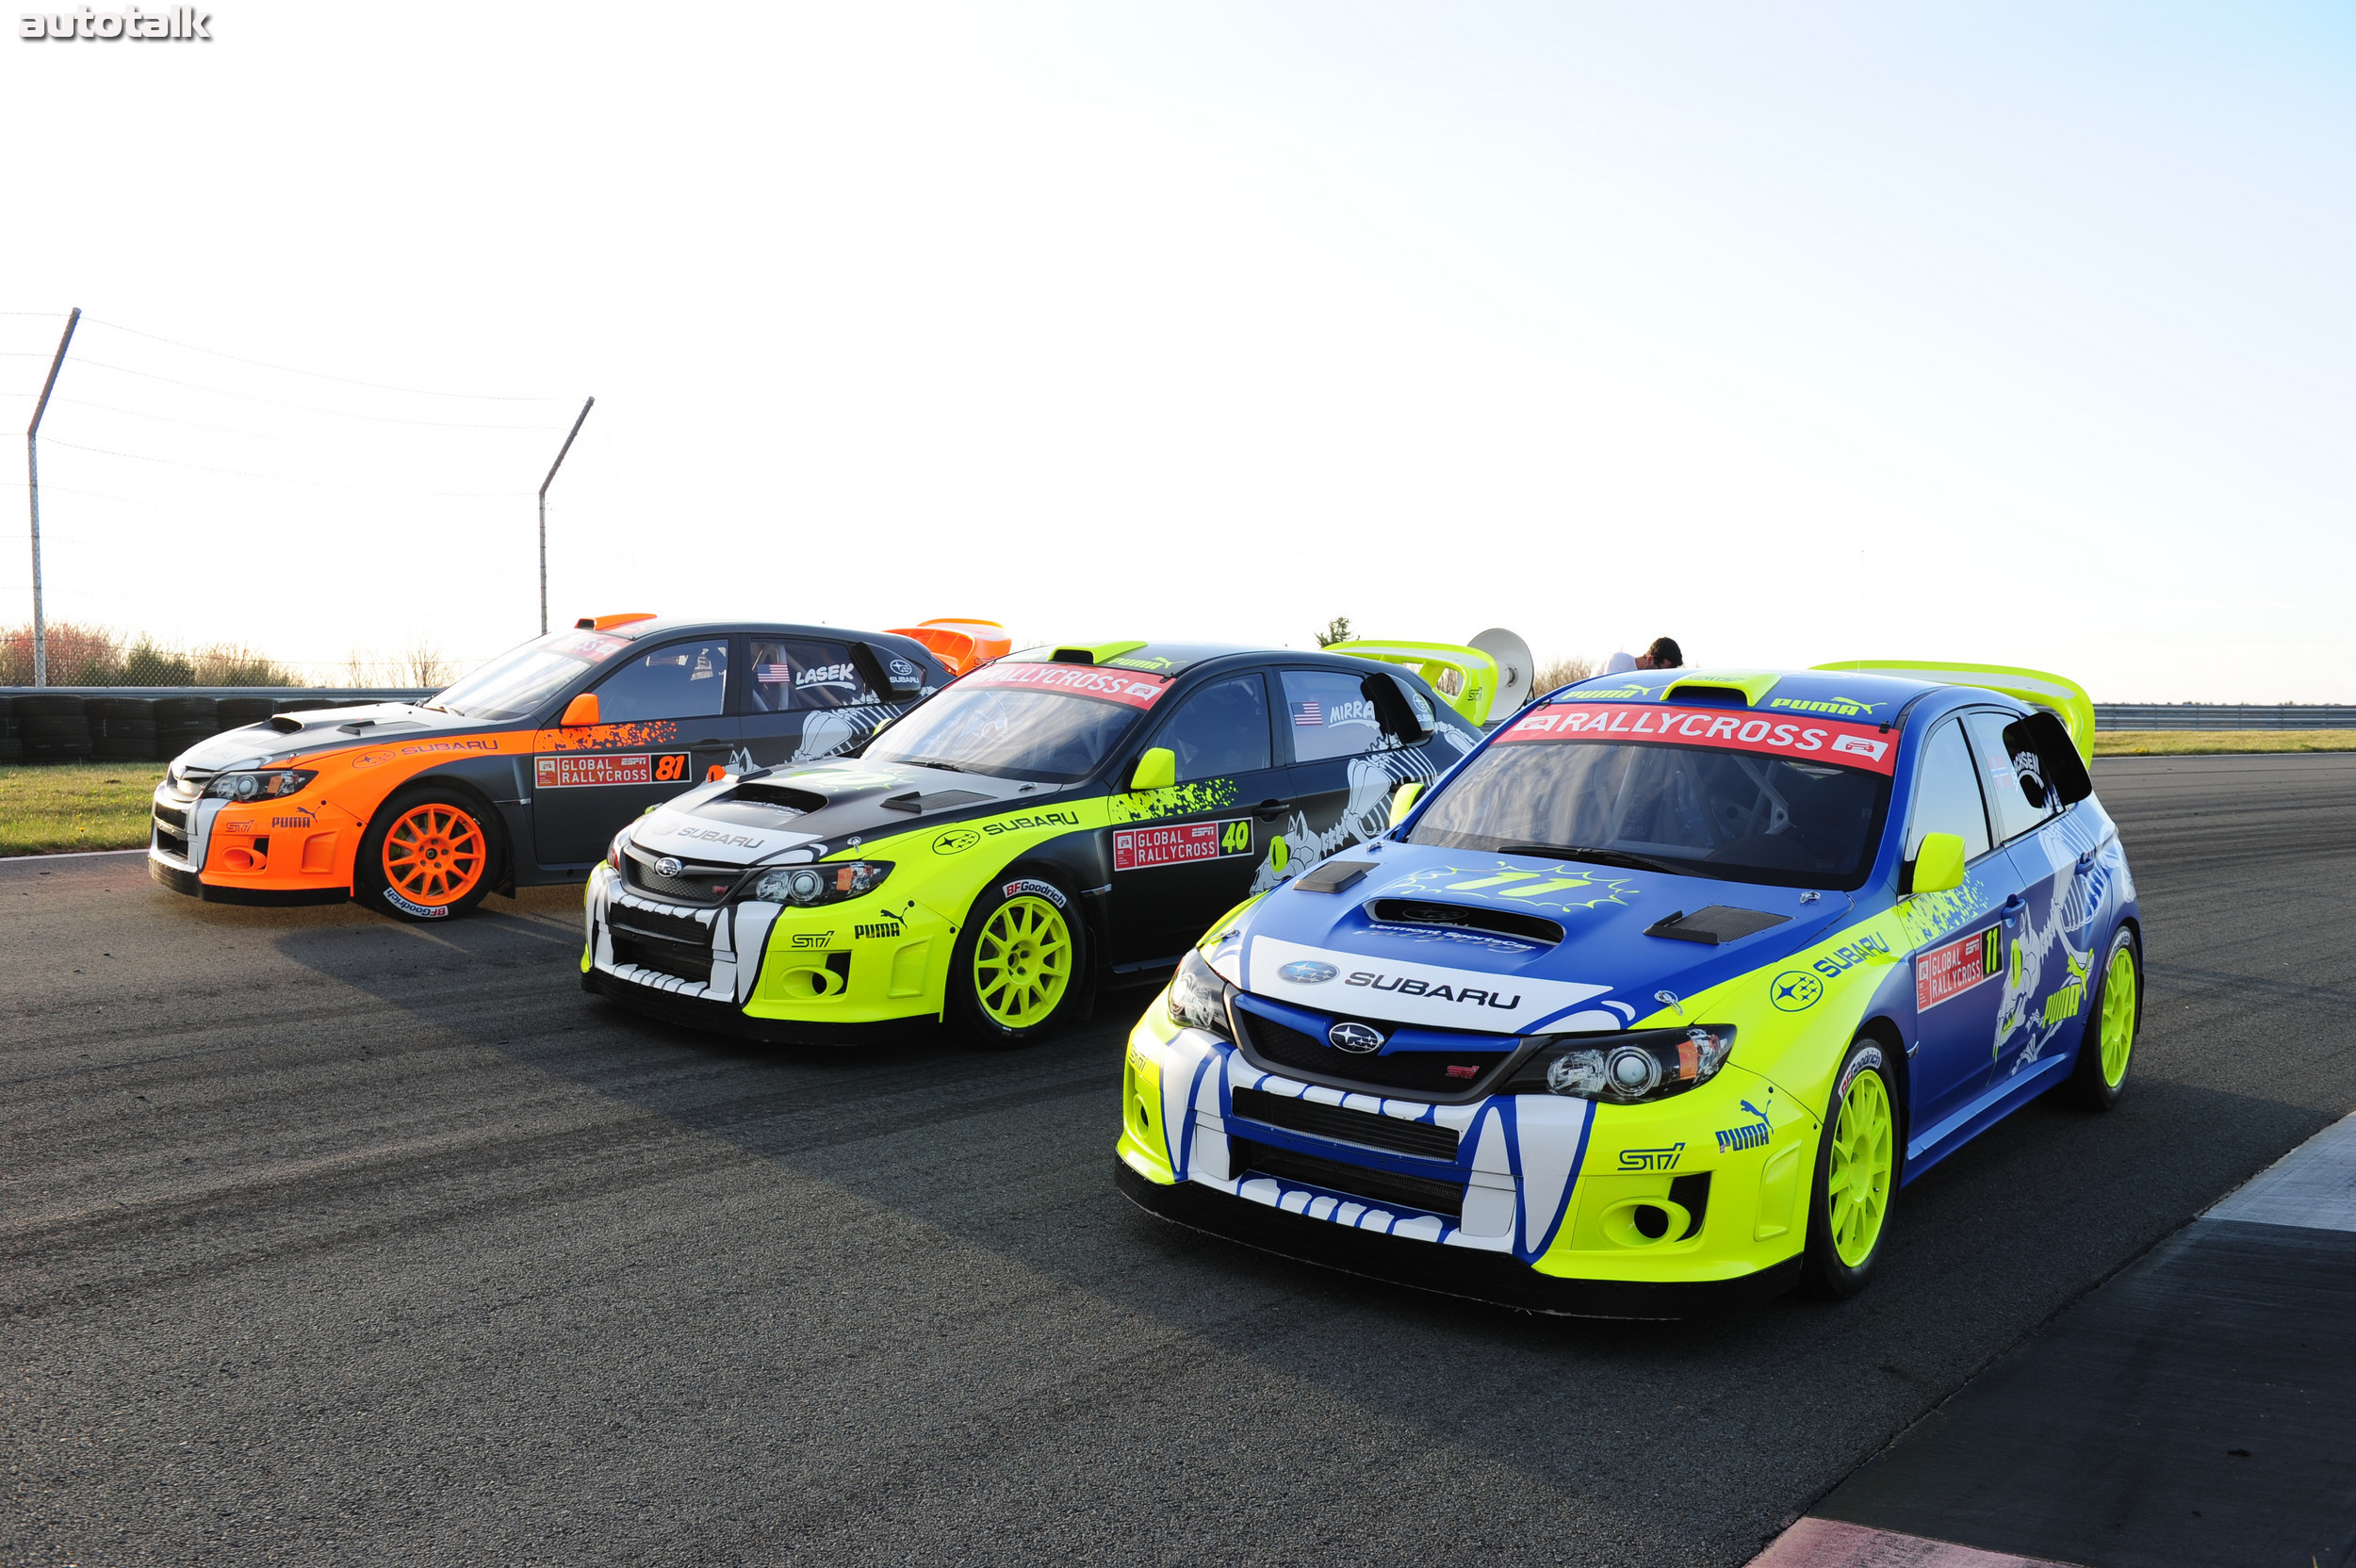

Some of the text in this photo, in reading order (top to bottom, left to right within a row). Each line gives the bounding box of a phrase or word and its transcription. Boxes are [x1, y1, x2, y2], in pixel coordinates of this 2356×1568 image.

[795, 662, 855, 685] LASEK
[1561, 690, 1639, 699] PUMA
[1330, 700, 1375, 723] MIRRA
[1770, 698, 1860, 715] PUMA
[1556, 711, 1828, 751] RALLYCROSS
[401, 740, 499, 755] SUBARU
[562, 759, 613, 771] GLOBAL
[562, 769, 647, 783] RALLYCROSS
[655, 755, 685, 780] 81
[271, 817, 310, 827] PUMA
[983, 811, 1079, 835] SUBARU
[1191, 826, 1214, 838] ESPN
[677, 827, 765, 848] SUBARU
[1137, 830, 1184, 847] GLOBAL
[1221, 821, 1249, 854] 40
[1138, 841, 1215, 862] RALLYCROSS
[1006, 881, 1065, 906] BFGoodrich
[1445, 871, 1594, 897] 11
[386, 890, 446, 916] BFGoodrich
[854, 923, 900, 939] PUMA
[1812, 931, 1890, 978] SUBARU
[1965, 939, 1980, 956] ESPN
[1986, 927, 1998, 973] 11
[1932, 947, 1961, 976] GLOBAL
[1932, 959, 1981, 999] RALLYCROSS
[1344, 972, 1522, 1010] SUBARU
[2042, 983, 2082, 1029] PUMA
[1715, 1122, 1770, 1154] PUMA
